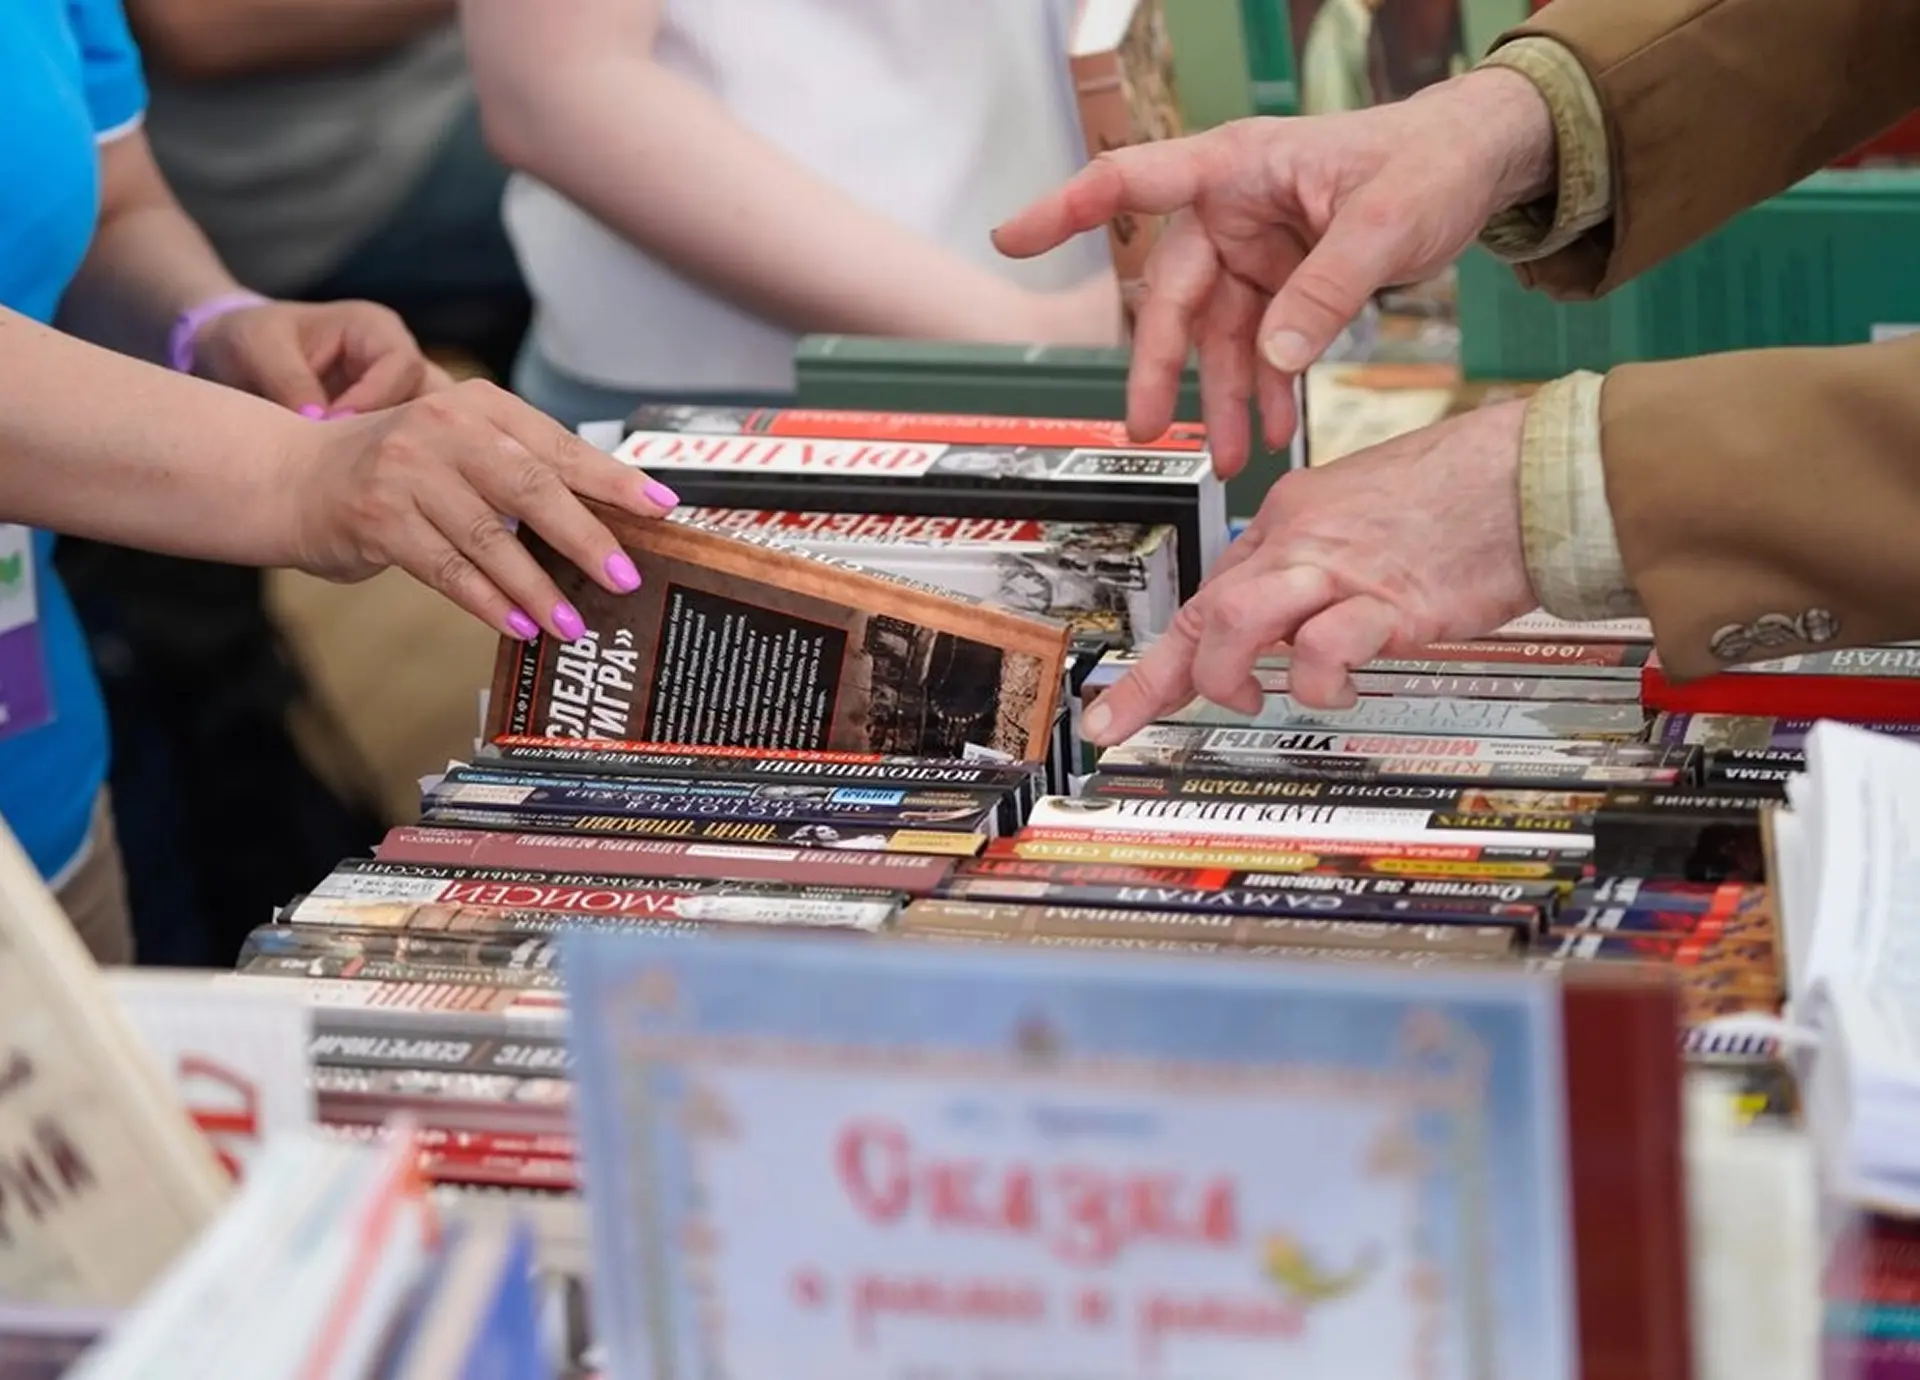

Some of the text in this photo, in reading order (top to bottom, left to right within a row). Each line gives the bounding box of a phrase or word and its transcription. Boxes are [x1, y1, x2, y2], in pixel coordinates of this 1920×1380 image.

[1523, 644, 1585, 659] 1000
[1832, 649, 1920, 667] ДНАЯ
[545, 629, 600, 739] СЛЕДЫ
[588, 629, 639, 740] ТИГРА»
[513, 657, 537, 737] ЛЬФГАНГ
[1209, 729, 1338, 750] УТРАТЫ
[1732, 749, 1805, 761] ТХЕМА
[754, 761, 981, 781] ВОСПОМИНАНИЯ
[1385, 759, 1484, 775] КРЫМ
[1725, 767, 1796, 781] ХЕМА
[1181, 779, 1322, 798] МОНГОЛОВ
[1328, 786, 1457, 799] ИСТОРИЯ
[565, 790, 872, 812] ОГНЕСТРЕЛЬНОГО ОРУЖИЯ
[625, 801, 794, 818] ИСТОРИЯ
[357, 863, 448, 878] РОССИИ
[471, 870, 546, 884] СЕМЬИ
[553, 876, 701, 891] ИСАТЕЛЬСКИЕ
[1242, 873, 1524, 901] Охотник за Головами
[1116, 886, 1343, 910] САМУРАЙ
[494, 1043, 575, 1069] ЕЙТС
[836, 1119, 1240, 1266] Сказка
